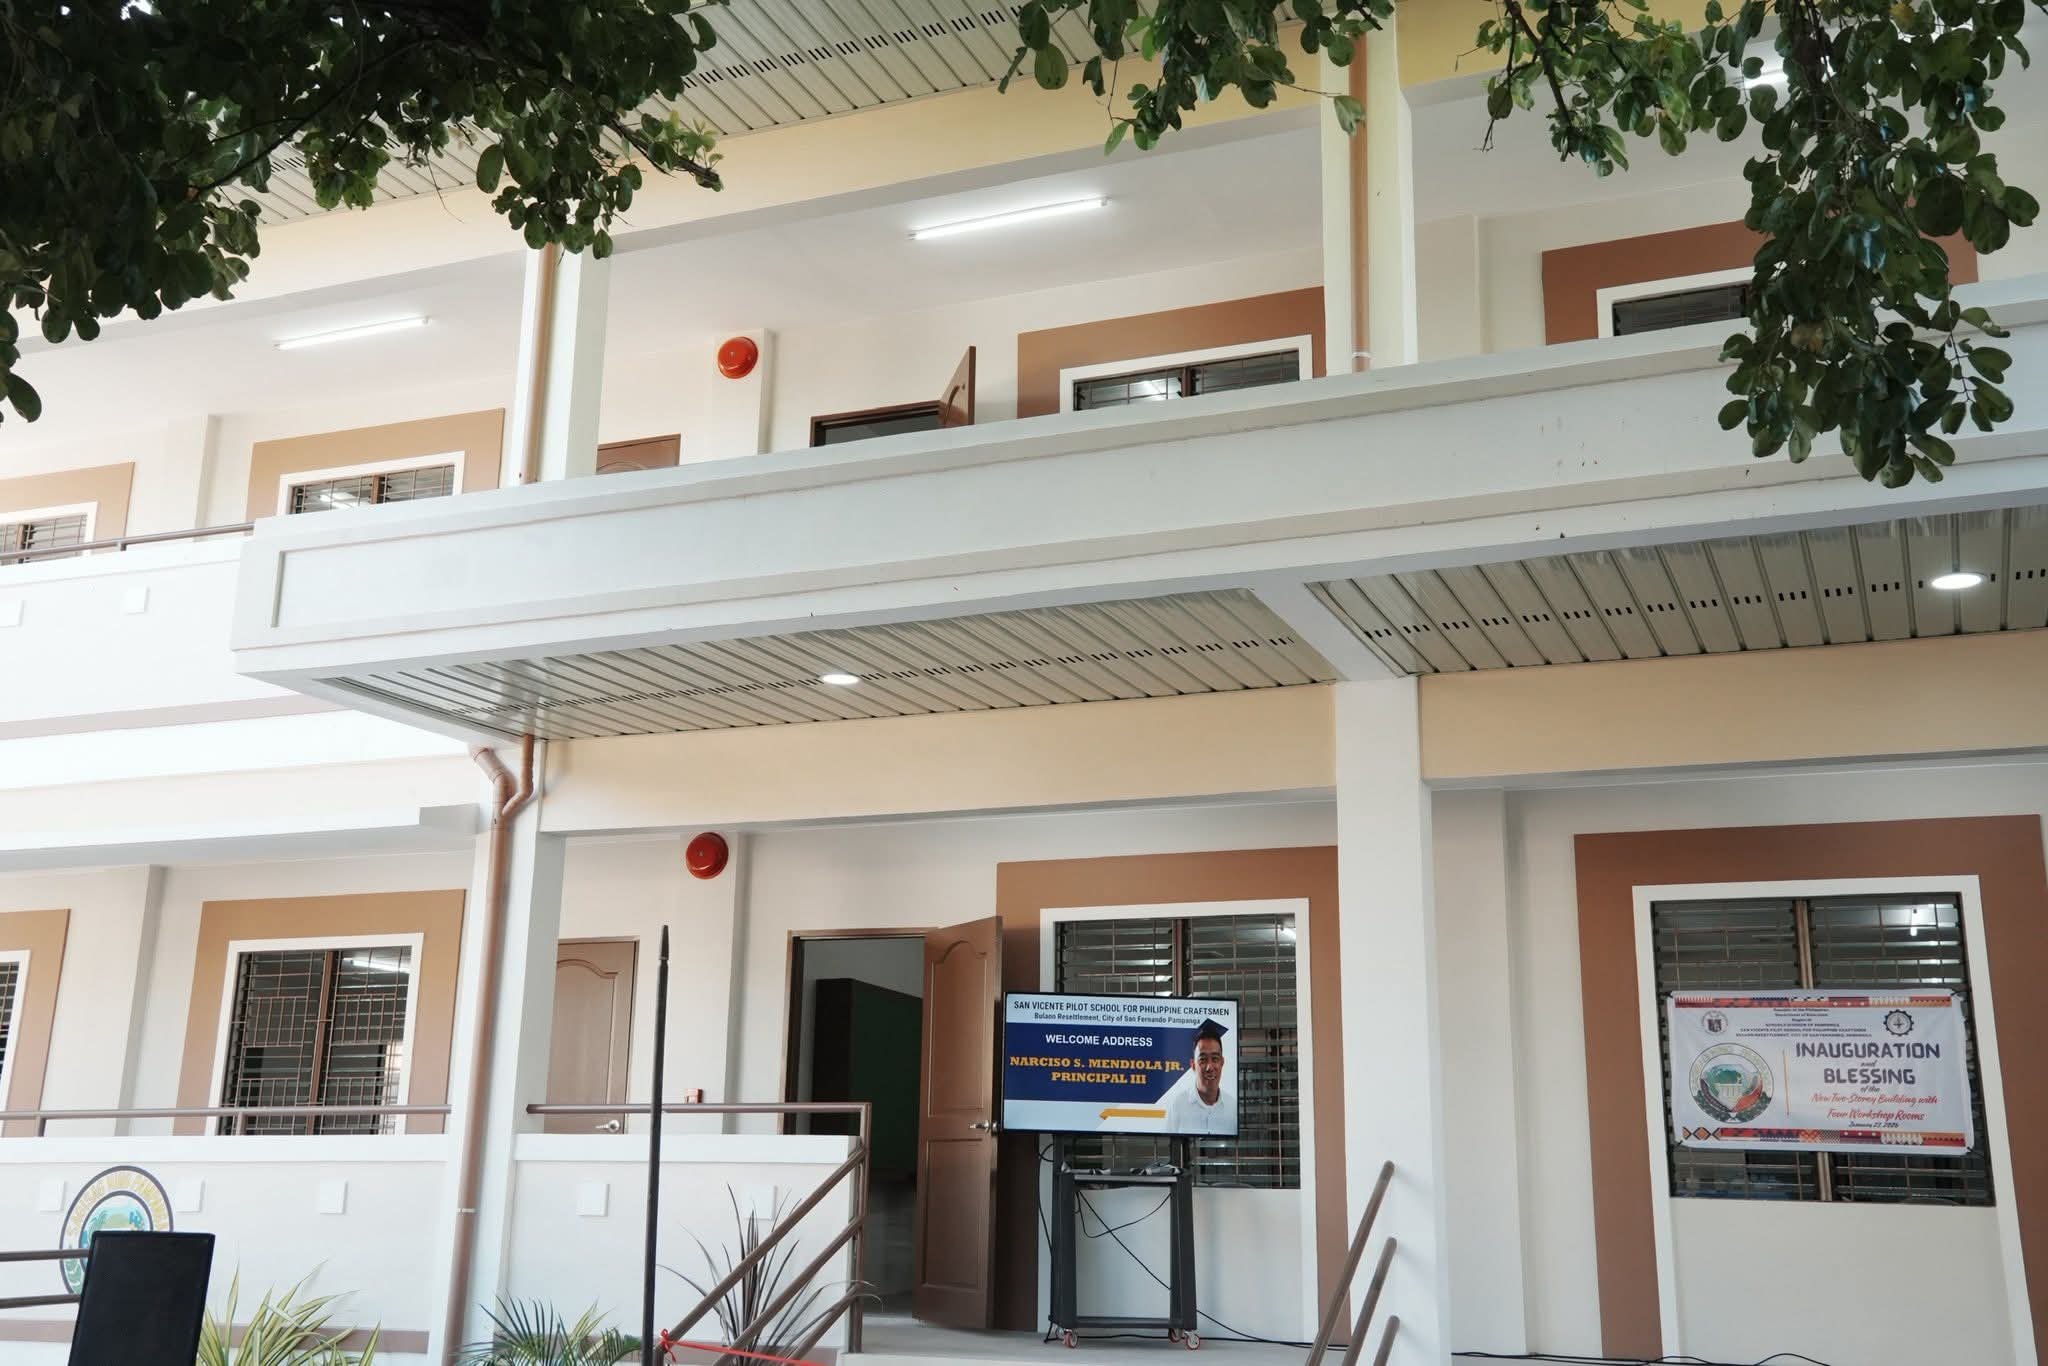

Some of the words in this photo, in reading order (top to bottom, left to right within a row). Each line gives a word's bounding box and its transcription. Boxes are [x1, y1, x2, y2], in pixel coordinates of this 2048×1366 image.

[1014, 1000, 1030, 1009] SAN
[1032, 1001, 1064, 1011] VICENTE
[1066, 1002, 1088, 1012] PILOT
[1090, 1003, 1120, 1013] SCHOOL
[1123, 1004, 1138, 1013] FOR
[1139, 1005, 1181, 1015] PHILIPPINE
[1183, 1007, 1230, 1016] CRAFTSMEN
[1102, 1014, 1114, 1022] City
[1168, 1017, 1200, 1025] Pampanga
[1045, 1034, 1100, 1046] WELCOME
[1102, 1036, 1153, 1047] ADDRESS
[1796, 1042, 1940, 1059] INAUGURATION
[1010, 1056, 1071, 1067] NARCISO
[1073, 1058, 1085, 1068] S.
[1088, 1058, 1163, 1070] MENDIOLA
[1164, 1060, 1185, 1072] JR.
[1051, 1071, 1128, 1084] PRINCIPAL
[1130, 1074, 1147, 1085] III
[1823, 1068, 1916, 1085] BLESSING
[1876, 1094, 1917, 1107] Building
[1918, 1095, 1938, 1104] with
[1826, 1108, 1848, 1120] Four
[1848, 1109, 1894, 1122] Workshop
[1895, 1110, 1925, 1121] Rooms
